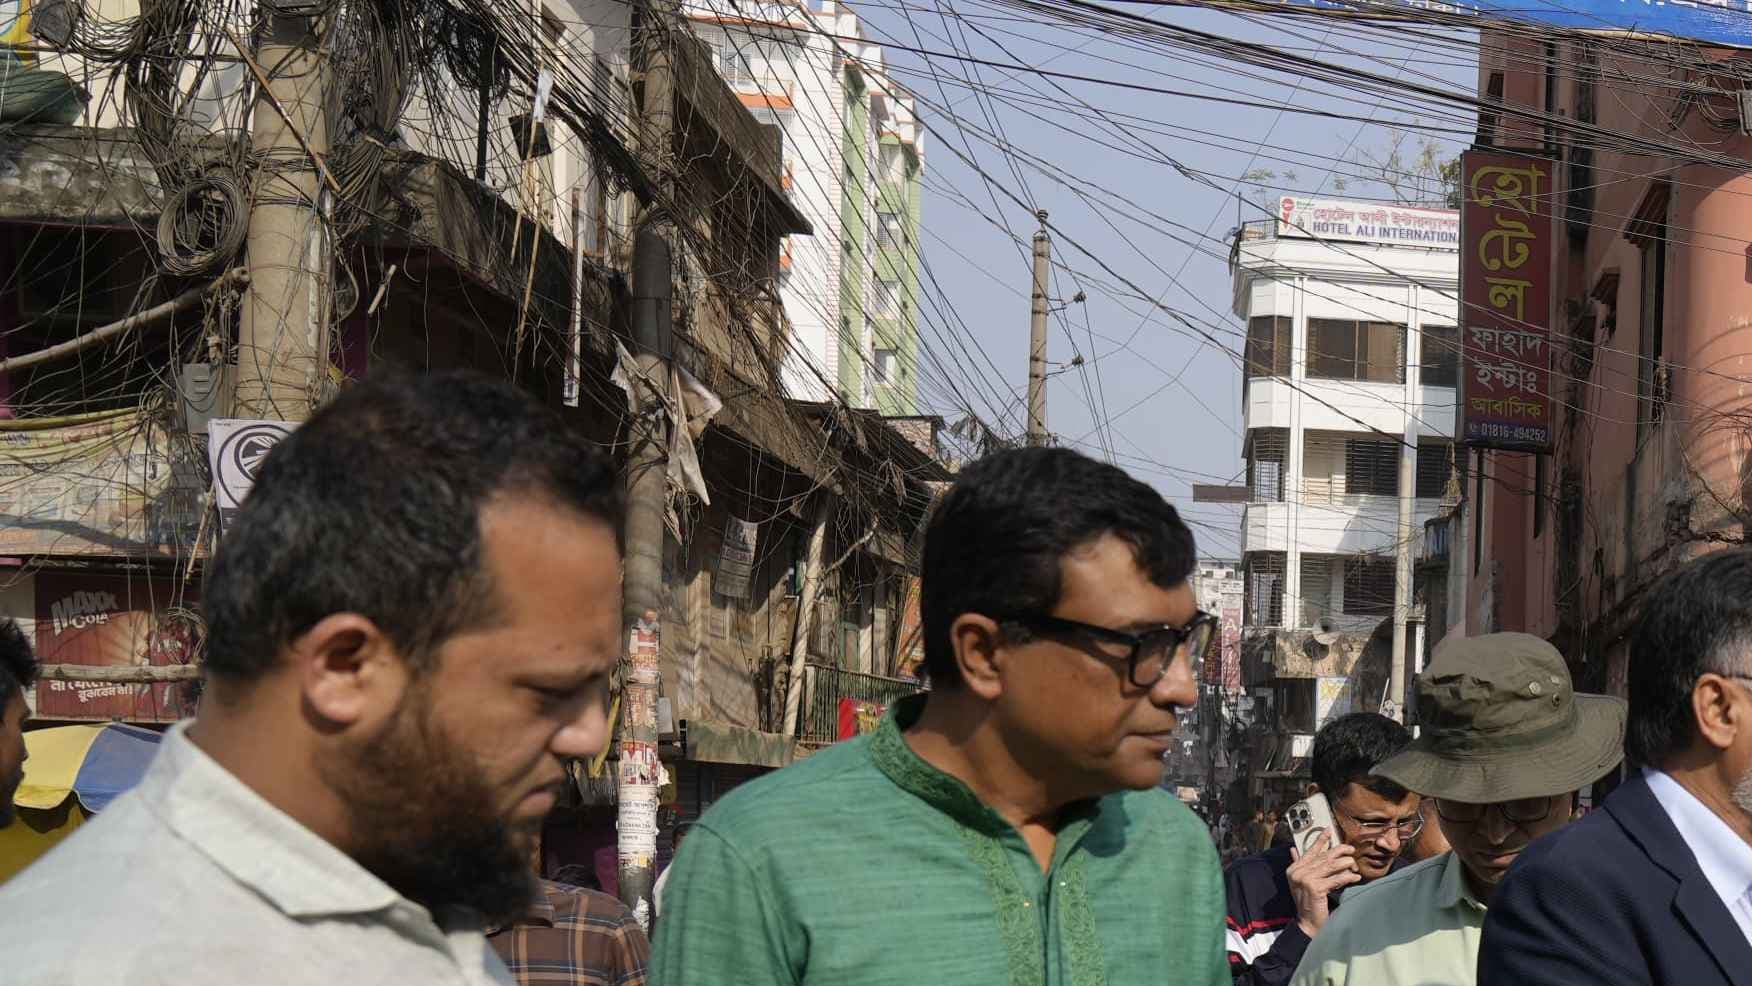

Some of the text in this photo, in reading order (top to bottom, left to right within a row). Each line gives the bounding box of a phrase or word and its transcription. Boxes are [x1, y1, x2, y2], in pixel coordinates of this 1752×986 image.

[1313, 221, 1352, 234] HOTEL
[1356, 226, 1375, 237] ALI
[1469, 326, 1544, 356] ফাহাদ
[1470, 396, 1543, 419] আবাসিক
[71, 612, 111, 630] COLA
